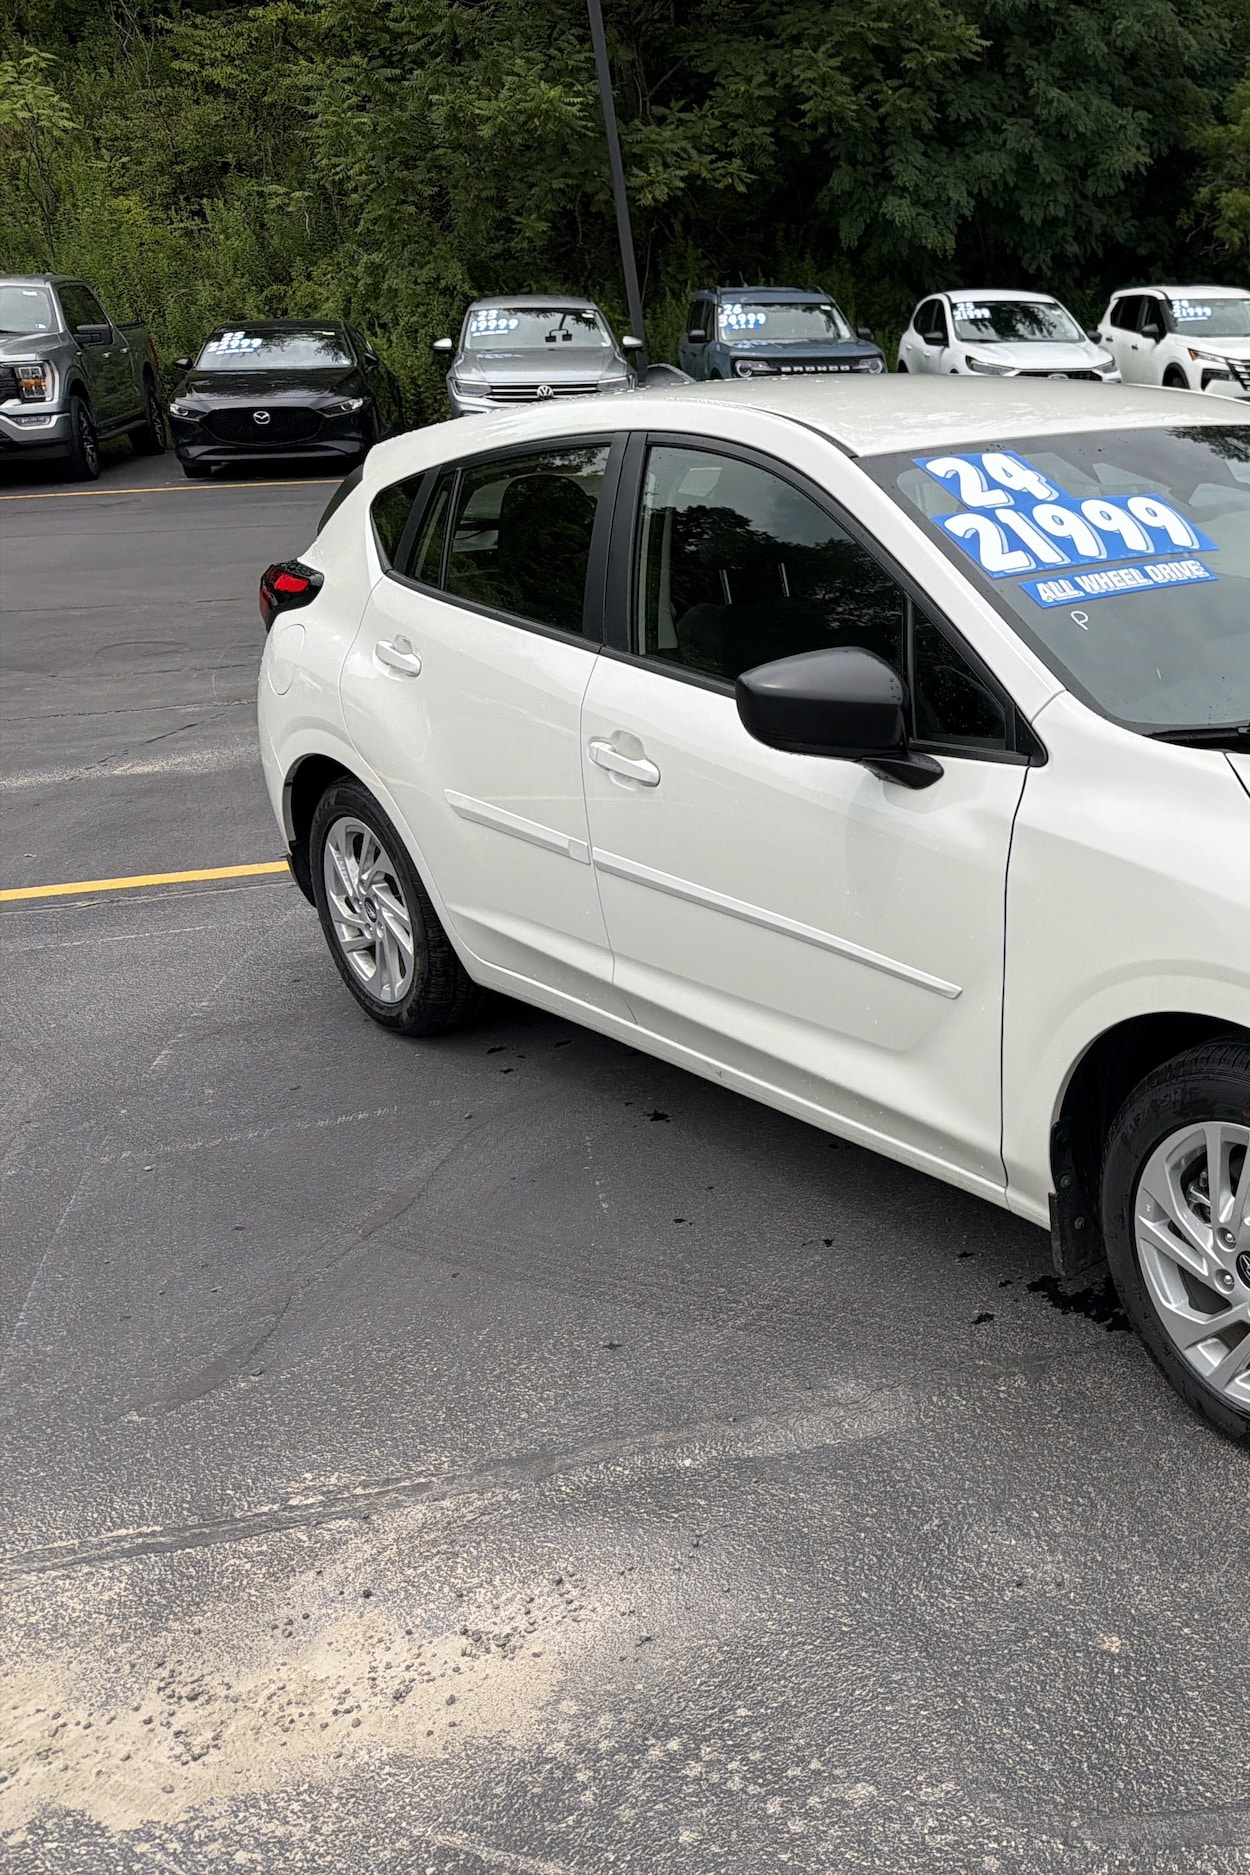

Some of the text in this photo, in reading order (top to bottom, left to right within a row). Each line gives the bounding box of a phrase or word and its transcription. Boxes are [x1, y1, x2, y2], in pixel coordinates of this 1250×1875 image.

[477, 310, 498, 320] 23
[723, 304, 742, 314] 26
[471, 319, 518, 332] 19999
[221, 331, 246, 341] 25
[207, 338, 263, 352] 22999
[925, 453, 1060, 508] 24
[944, 496, 1200, 574] 21999
[1035, 560, 1210, 602] ALL WHEEL DRIVE
